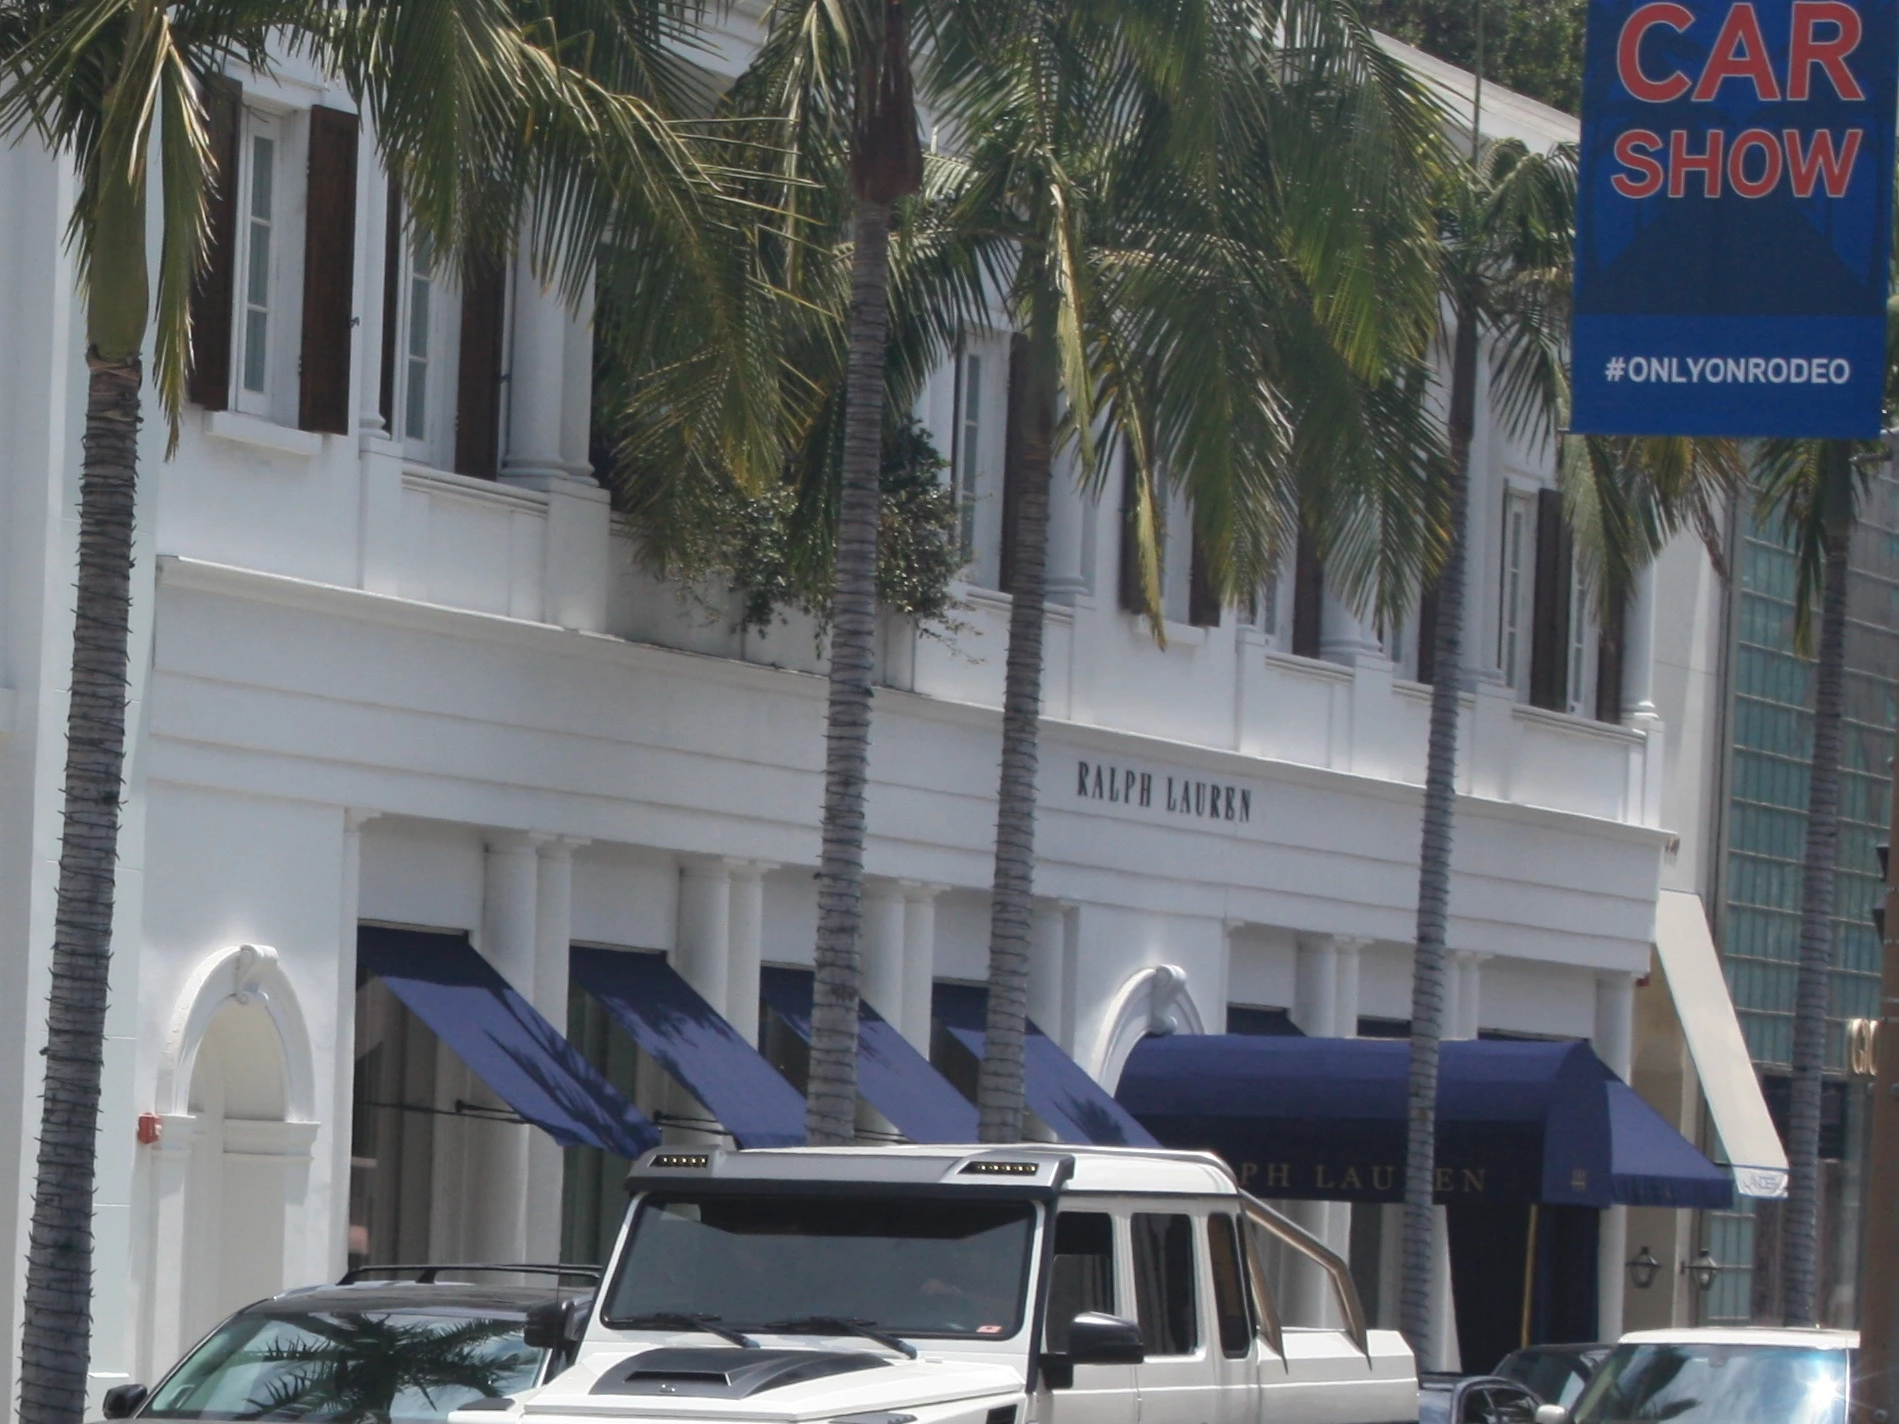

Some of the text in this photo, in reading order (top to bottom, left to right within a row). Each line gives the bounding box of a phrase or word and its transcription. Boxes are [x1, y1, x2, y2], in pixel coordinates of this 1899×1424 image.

[1616, 2, 1865, 103] CAR
[1610, 129, 1863, 199] SHOW
[1605, 356, 1851, 385] #ONLYONRODEO
[1077, 761, 1251, 822] RALPH LAUREN
[1315, 1163, 1487, 1193] LAUEN
